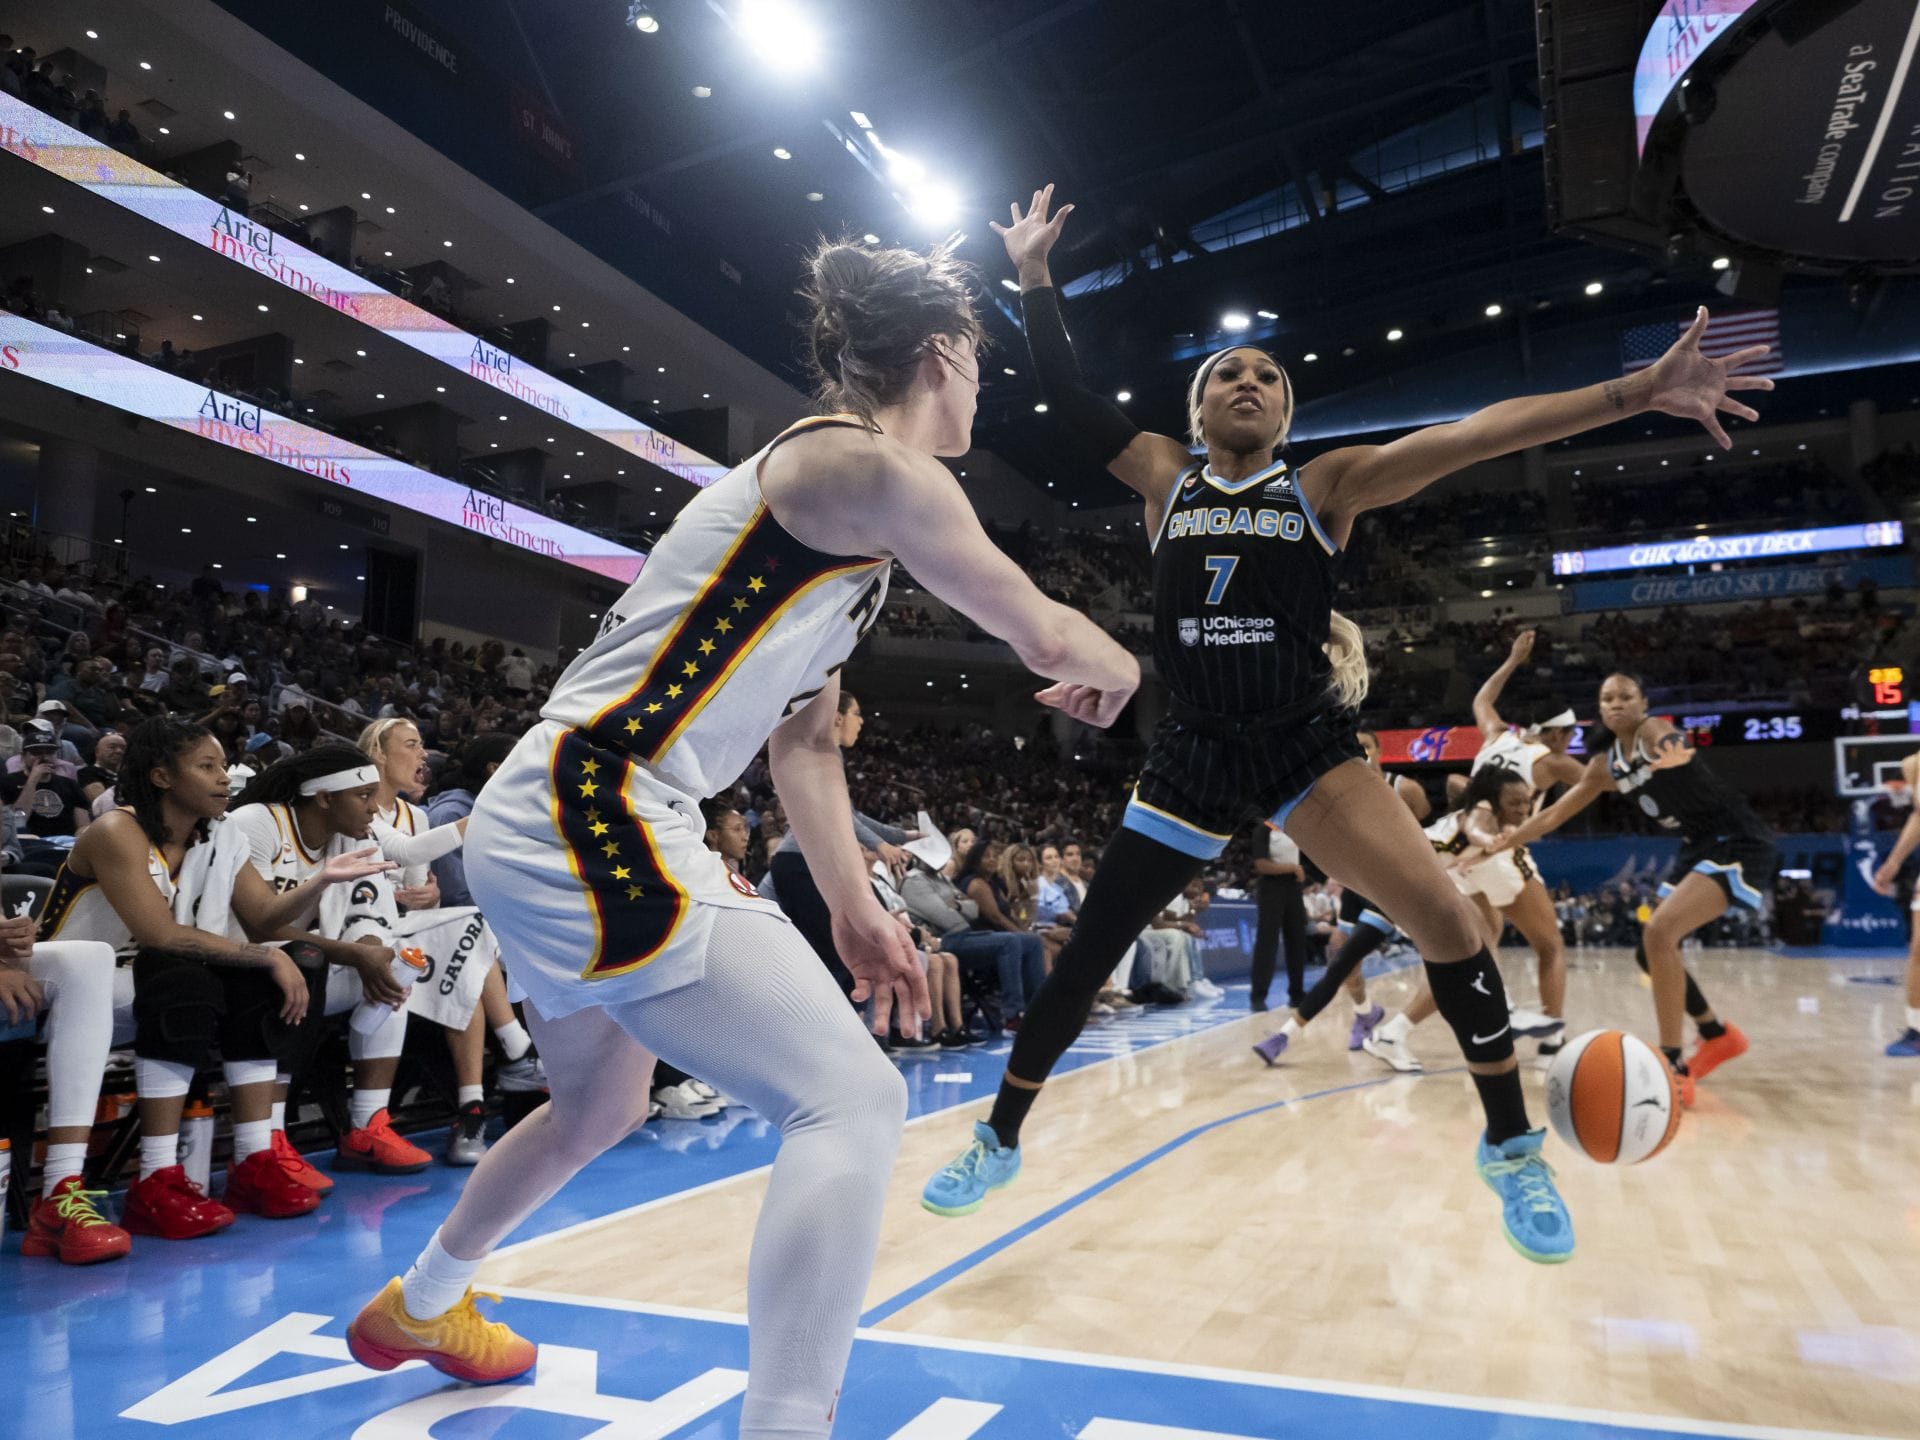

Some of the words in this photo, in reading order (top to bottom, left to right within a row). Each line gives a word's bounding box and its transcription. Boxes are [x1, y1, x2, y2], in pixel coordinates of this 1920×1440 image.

[384, 3, 458, 75] PROVIDENCE
[1824, 60, 1877, 140] SeaTrade
[1795, 143, 1842, 204] company
[211, 206, 273, 257] Ariel
[470, 338, 511, 376] Ariel
[198, 388, 261, 434] Ariel
[644, 430, 675, 458] Ariel
[463, 488, 504, 522] Ariel
[1167, 507, 1304, 541] CHICAGO
[1629, 540, 1715, 566] CHICAGO
[1716, 538, 1758, 558] SKY
[1759, 531, 1817, 555] DECK
[1205, 555, 1240, 605] 7
[1631, 577, 1732, 603] CHICAGO
[1735, 573, 1780, 595] SKY
[1203, 616, 1275, 631] UChicago
[1204, 630, 1275, 646] Medicine
[1874, 682, 1902, 704] 15
[1744, 716, 1802, 740] 2:35
[439, 912, 484, 996] GATORA
